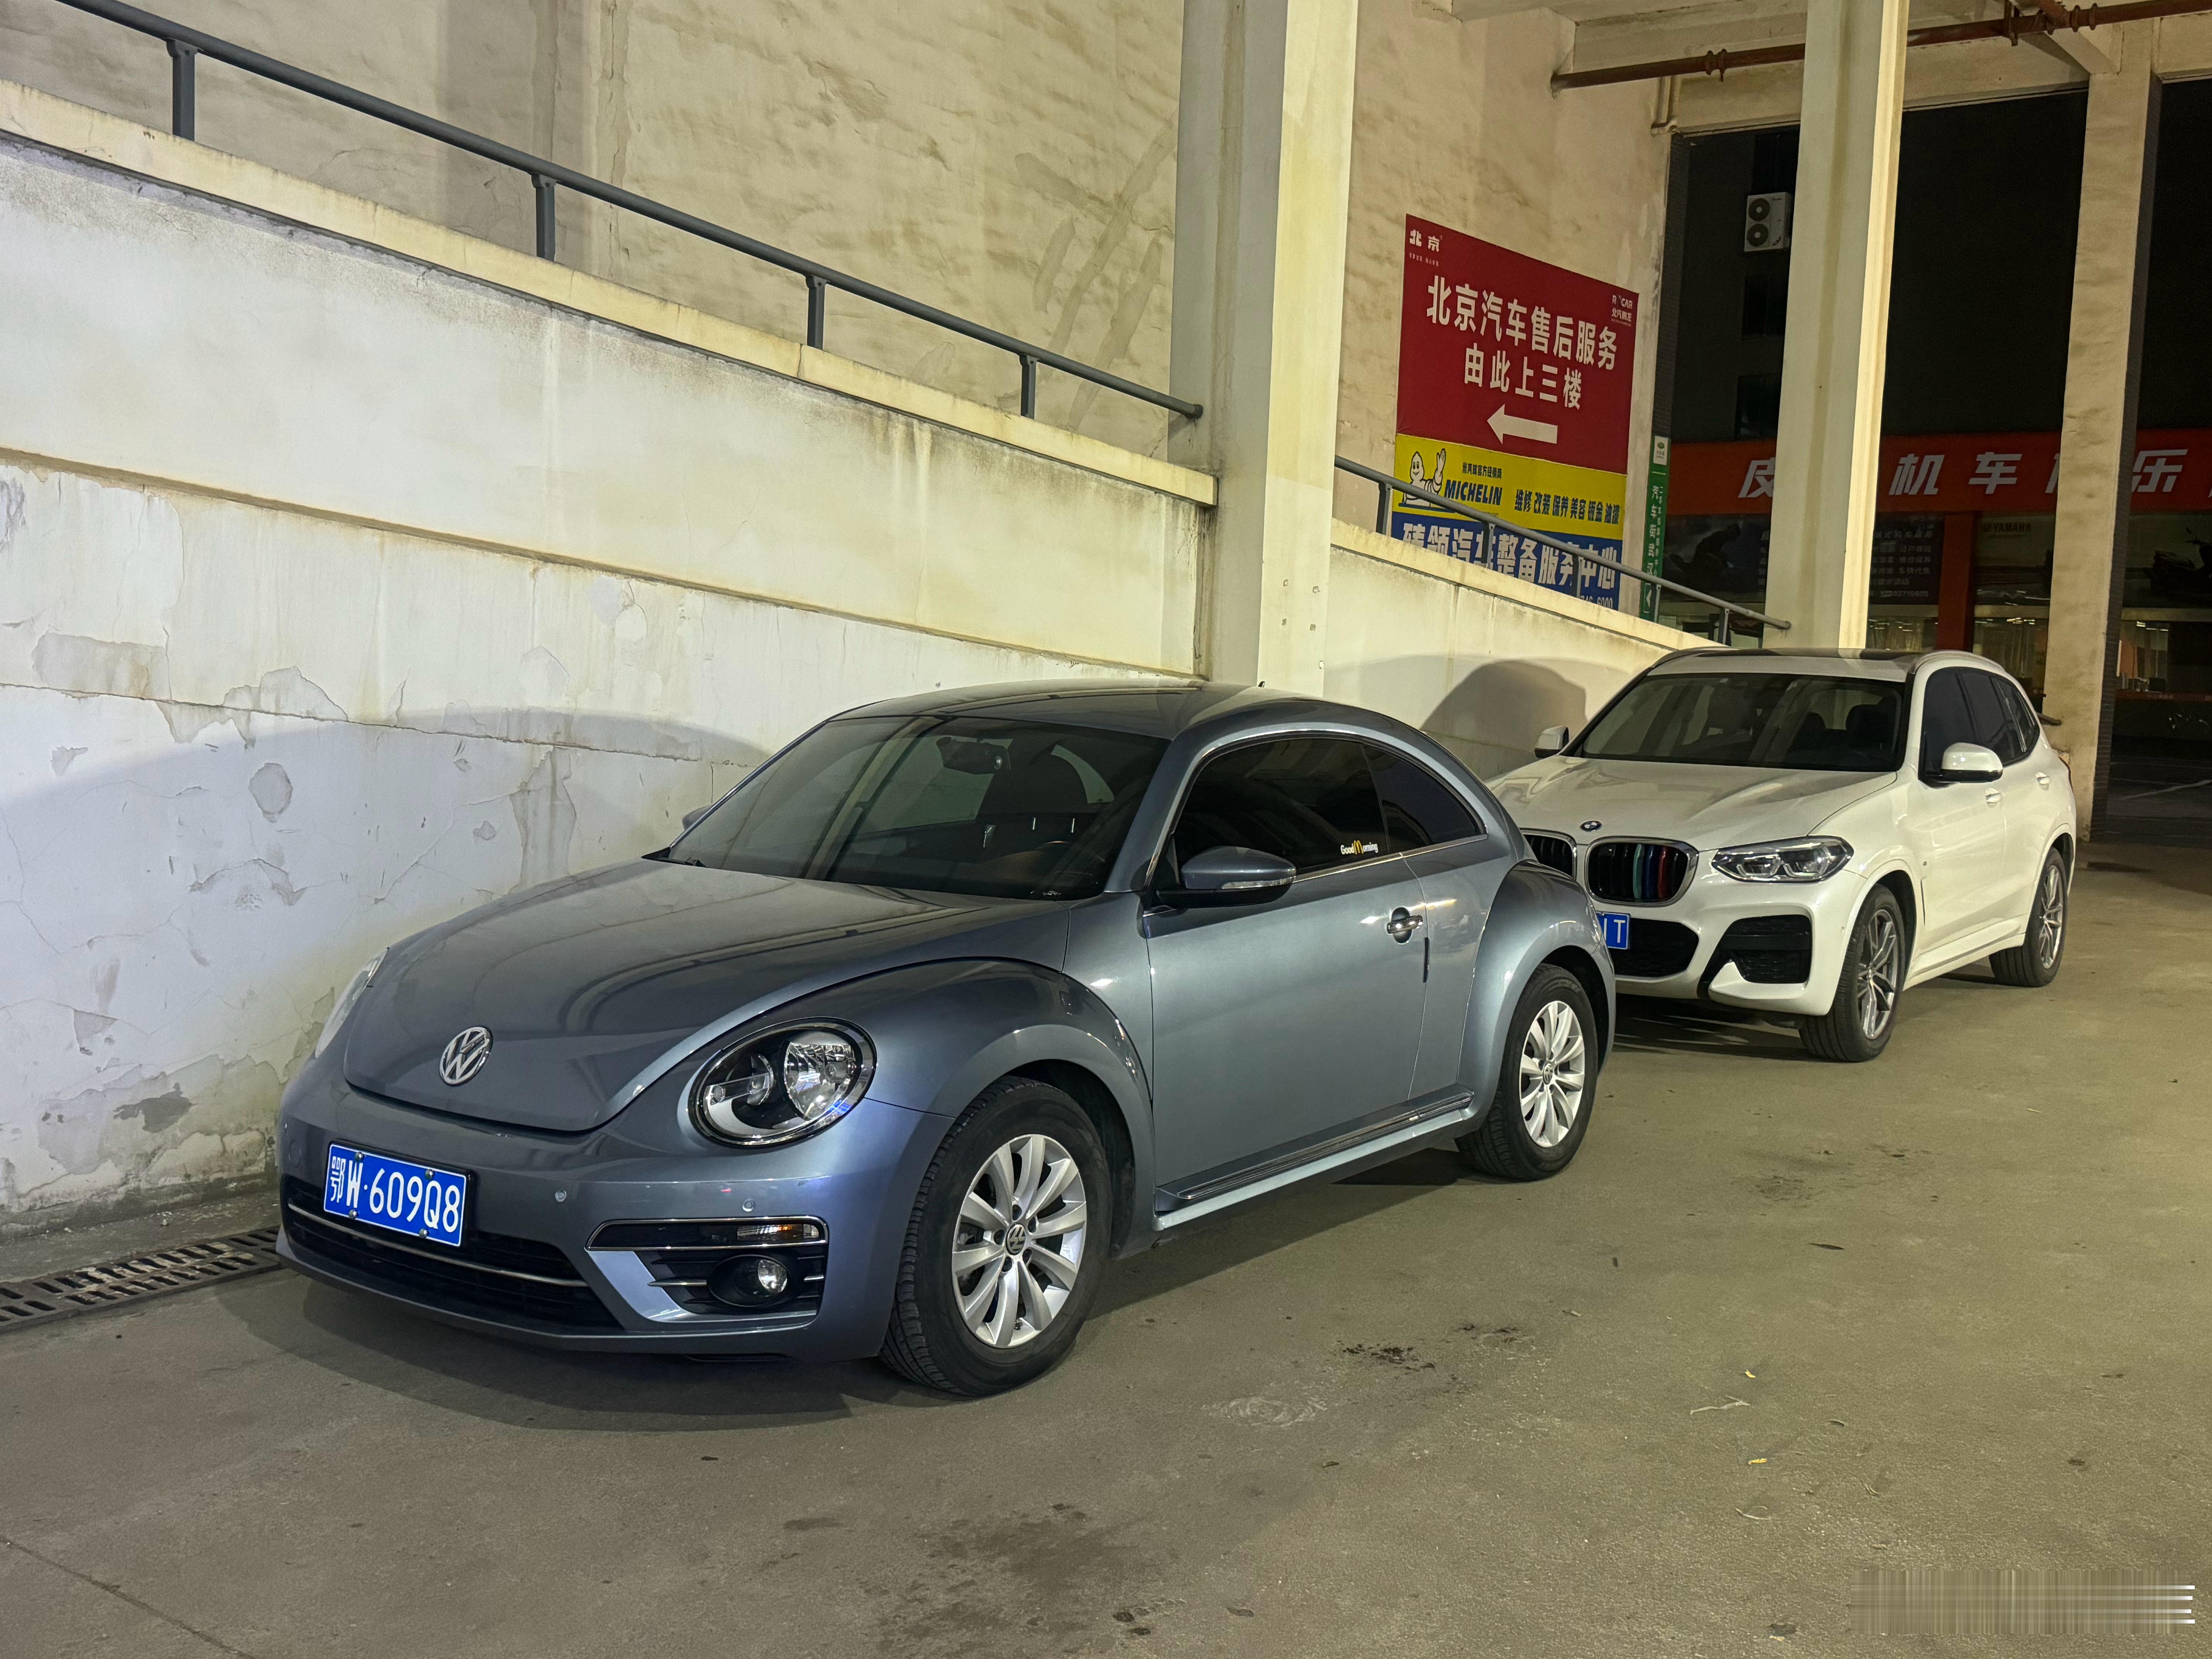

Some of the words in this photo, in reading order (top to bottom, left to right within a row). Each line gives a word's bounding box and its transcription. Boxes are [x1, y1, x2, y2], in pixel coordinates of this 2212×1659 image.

[1410, 229, 1440, 252] 北京
[1612, 295, 1633, 309] RCAR
[1426, 275, 1617, 370] 北京汽车售后服务
[1464, 343, 1582, 409] 由此上三楼
[1444, 479, 1503, 505] MICHELIN
[1515, 489, 1532, 512] 维修
[1534, 491, 1550, 514] 改装
[1552, 495, 1569, 517] 保养
[1570, 497, 1585, 520] 美容
